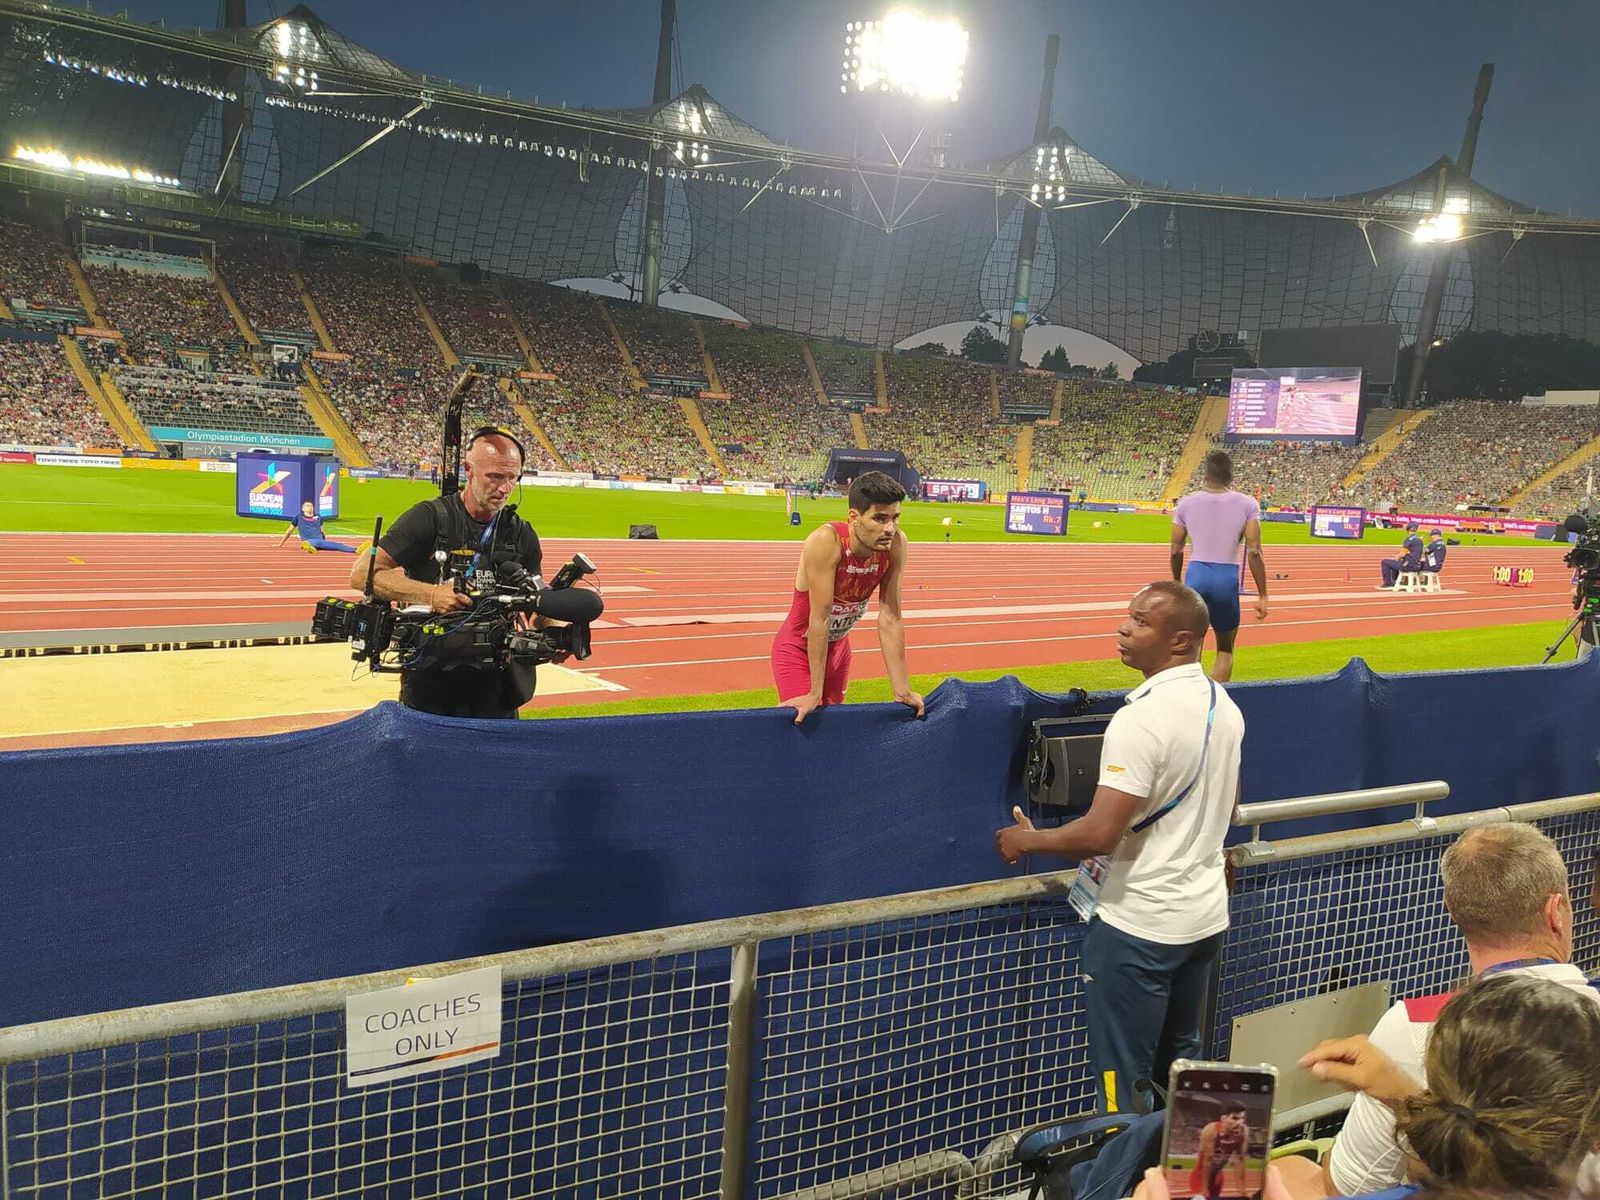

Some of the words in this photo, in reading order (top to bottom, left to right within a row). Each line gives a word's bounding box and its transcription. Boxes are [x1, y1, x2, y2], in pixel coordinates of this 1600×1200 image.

[187, 430, 257, 443] Olympiastadion
[259, 434, 300, 445] München
[1010, 505, 1042, 514] SANTOS
[1493, 565, 1511, 583] 1:00
[1518, 567, 1535, 584] 1:00
[365, 993, 481, 1033] COACHES
[395, 1027, 459, 1056] ONLY
